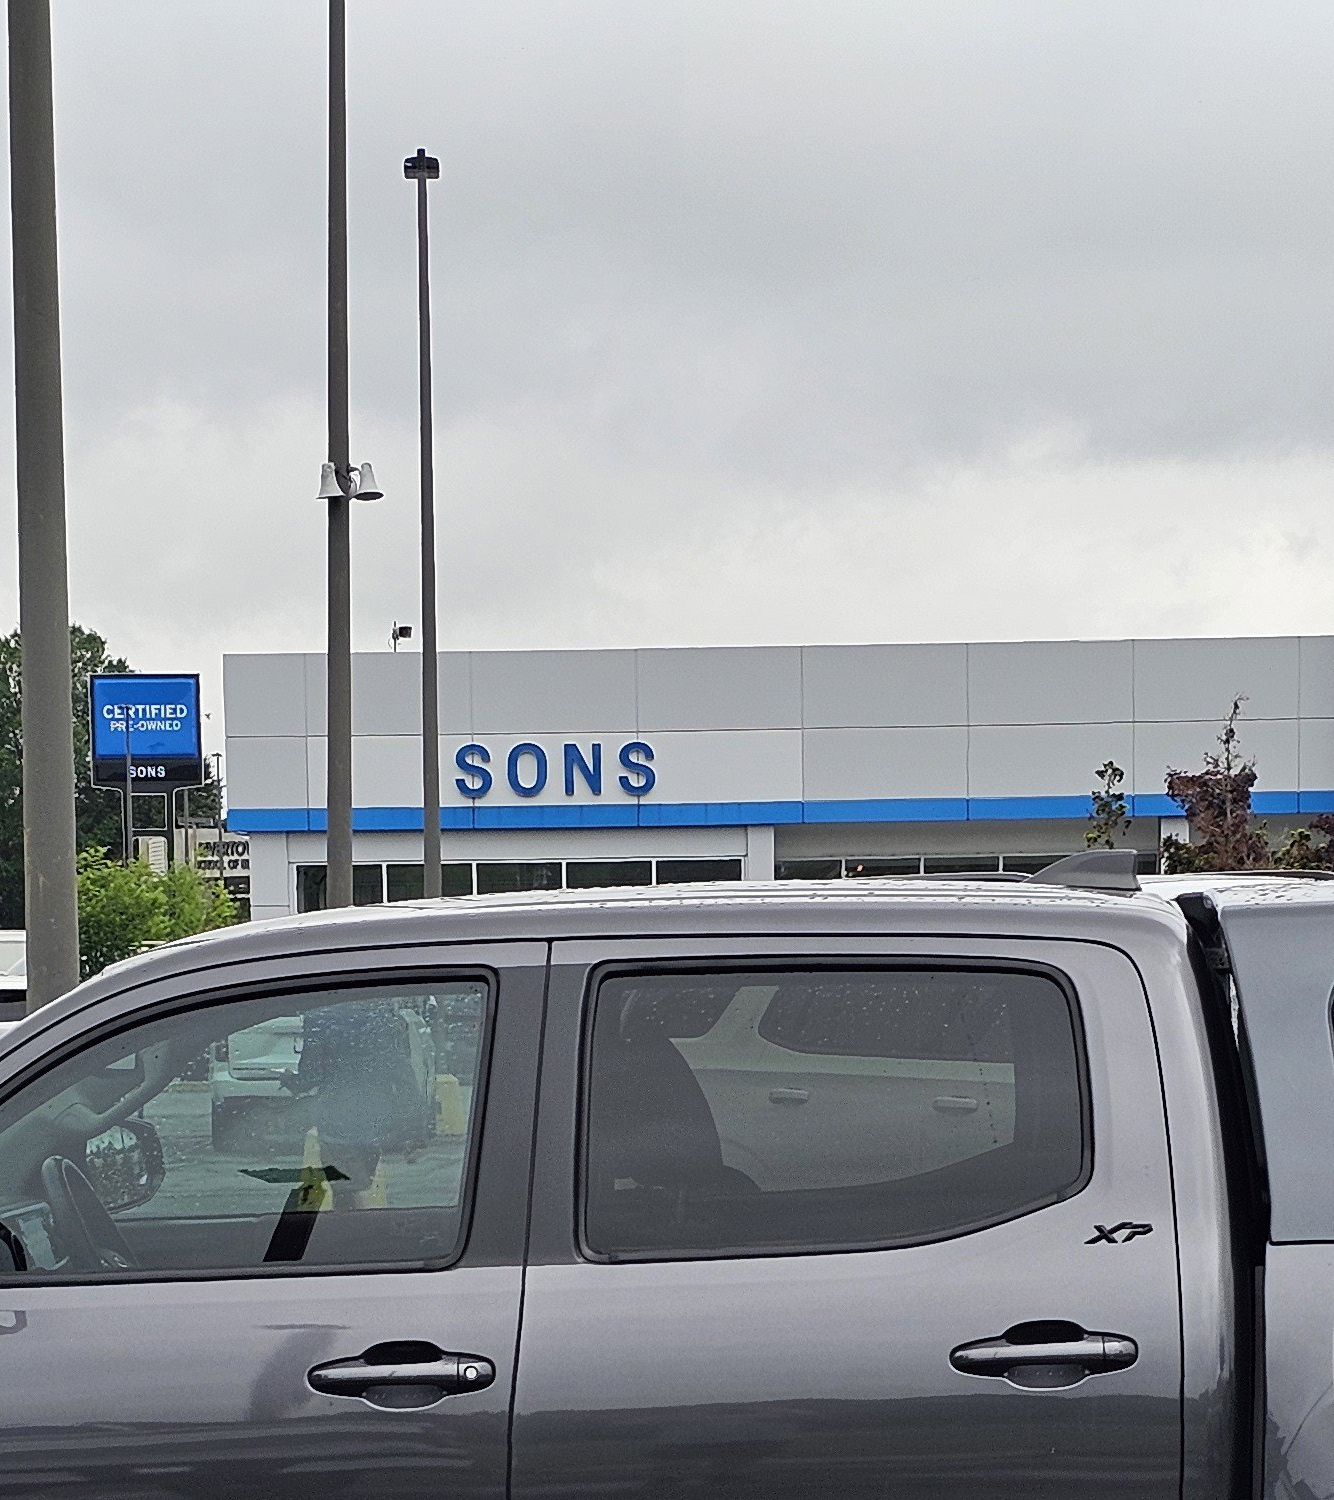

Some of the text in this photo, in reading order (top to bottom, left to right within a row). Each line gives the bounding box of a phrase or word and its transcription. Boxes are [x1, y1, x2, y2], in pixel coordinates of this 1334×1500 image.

[102, 704, 188, 719] CERTIFIED
[110, 720, 182, 732] PRE-OWNED
[129, 765, 166, 778] SONS
[454, 741, 656, 797] SONS
[1083, 1221, 1154, 1245] XP
